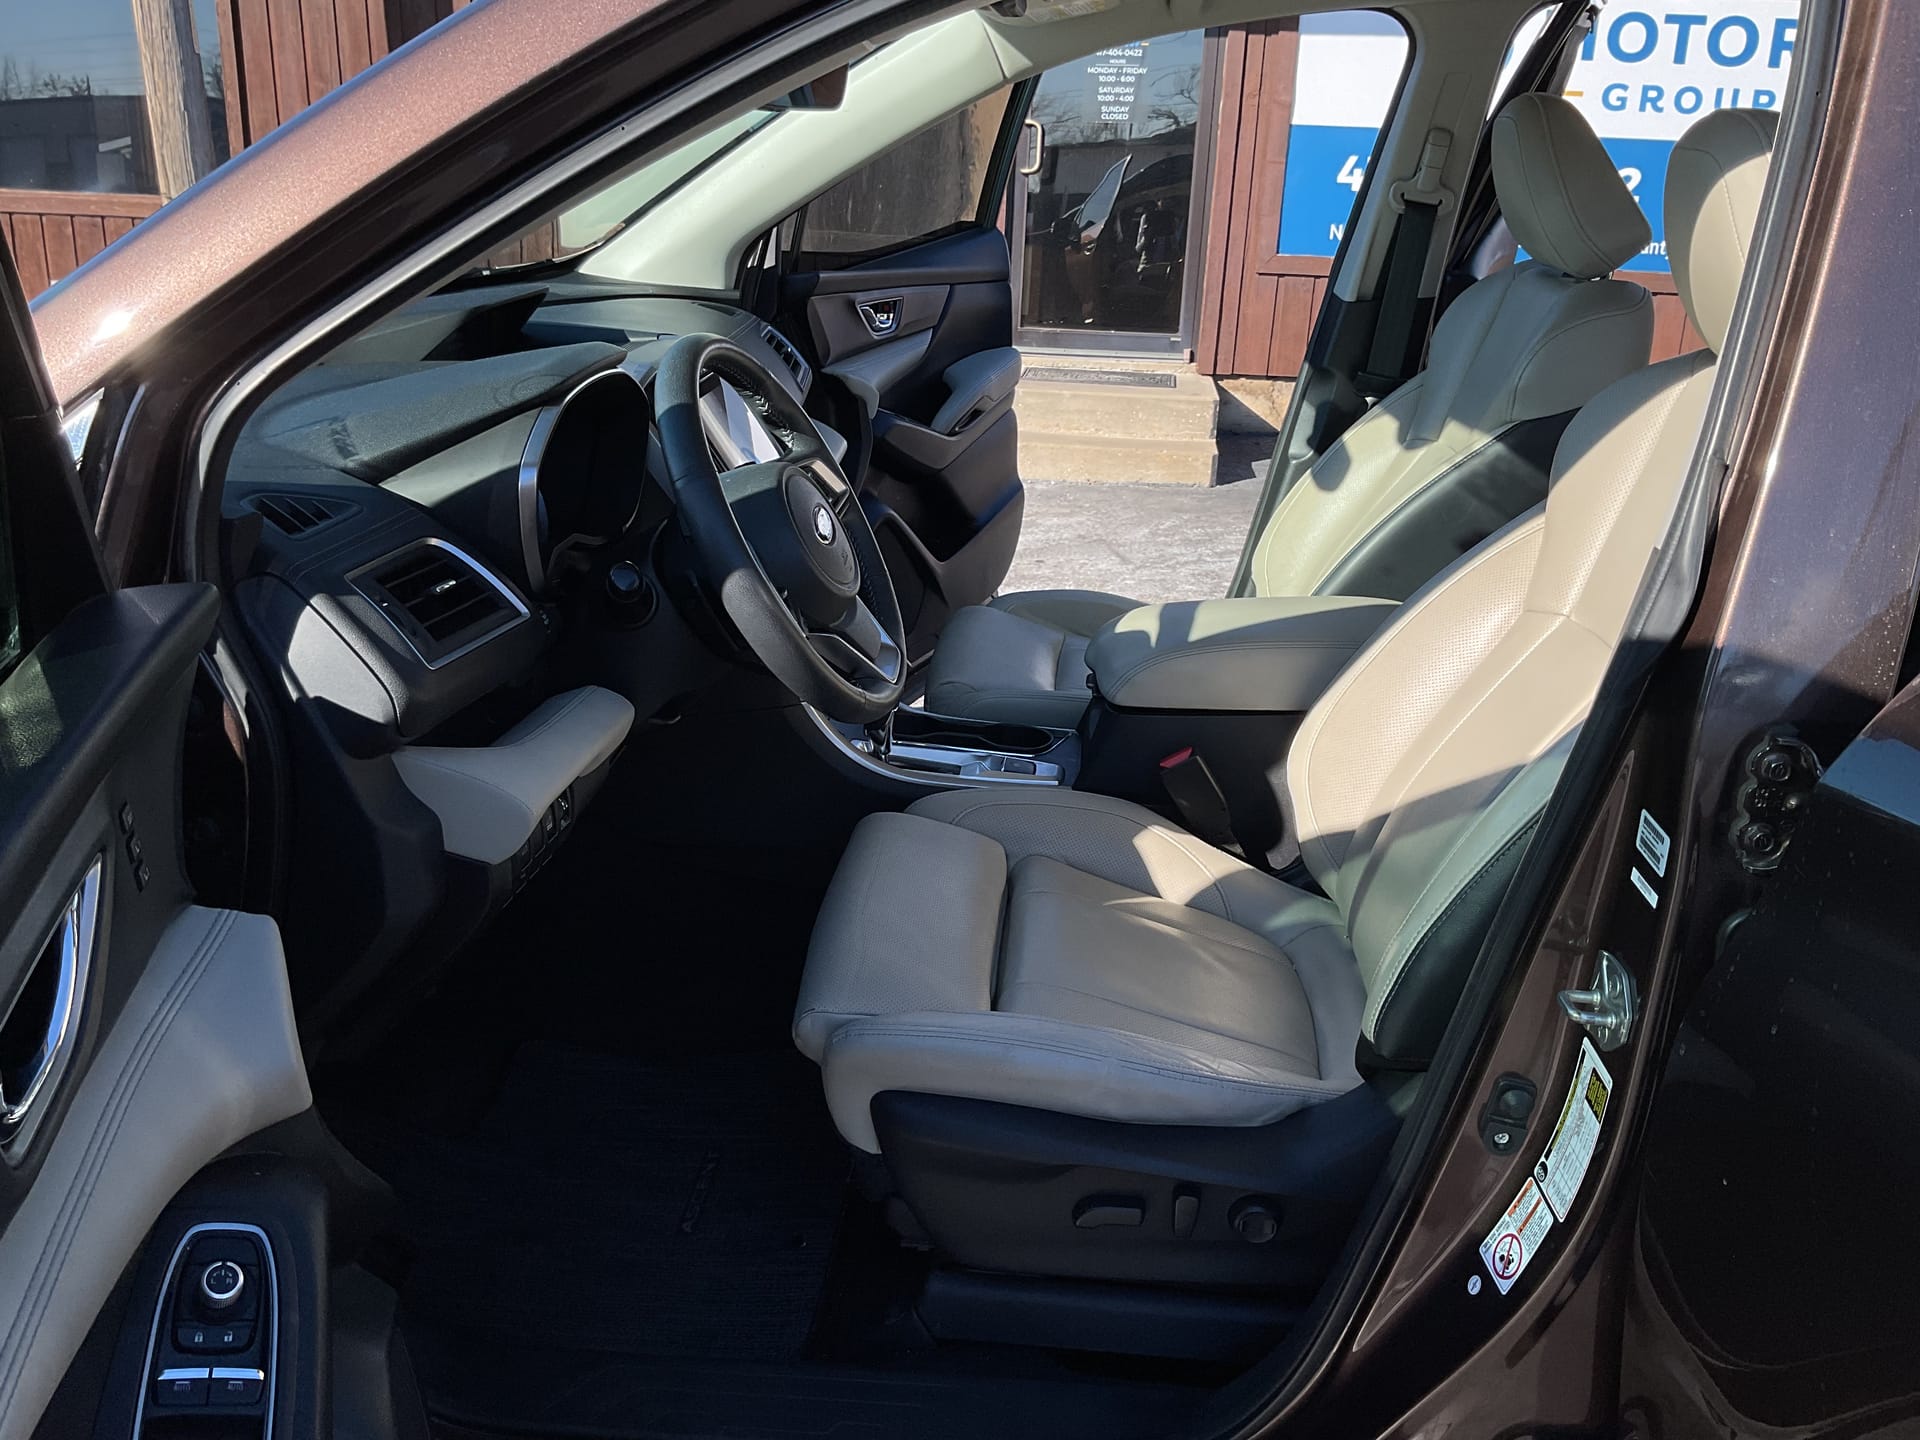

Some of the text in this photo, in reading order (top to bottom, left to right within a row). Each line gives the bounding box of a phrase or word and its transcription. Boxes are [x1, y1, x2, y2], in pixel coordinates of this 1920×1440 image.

[1087, 66, 1118, 74] MONDAY
[1122, 67, 1148, 75] FRIDAY
[1098, 86, 1135, 94] SATURDAY
[1101, 105, 1130, 113] SUNDAY
